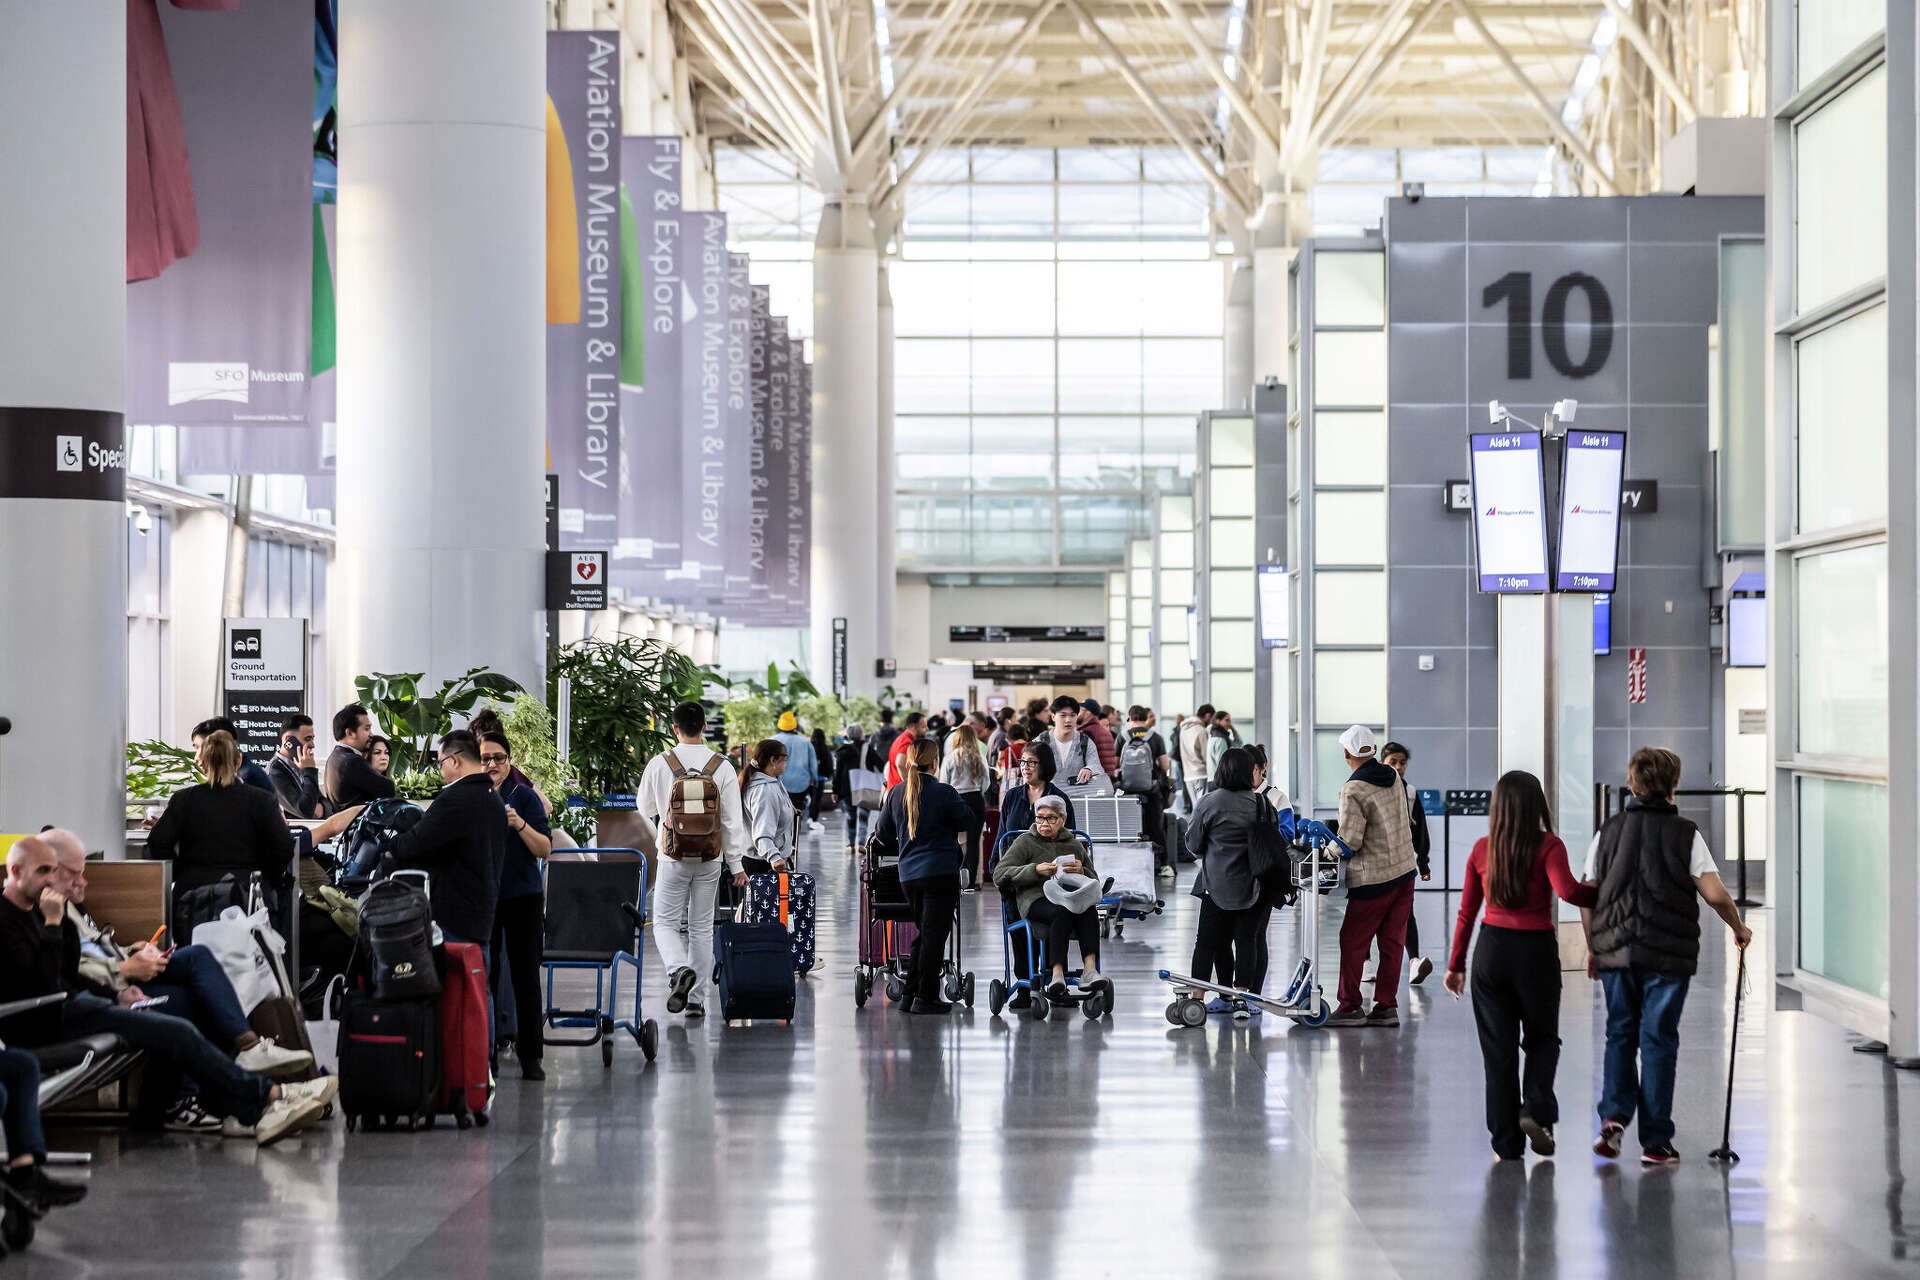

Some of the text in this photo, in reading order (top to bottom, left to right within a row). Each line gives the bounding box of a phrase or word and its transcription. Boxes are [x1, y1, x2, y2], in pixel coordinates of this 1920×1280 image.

[586, 35, 616, 172] Aviation
[586, 183, 616, 328] Museum
[648, 139, 680, 333] Fly & Explore
[703, 214, 725, 314] Aviation
[586, 338, 616, 362] &
[727, 255, 750, 410] Fly & Explore
[1482, 271, 1613, 380] 10
[215, 369, 305, 382] SFO Museum
[703, 322, 725, 429] Museum
[770, 372, 788, 451] Explore
[578, 373, 616, 488] Library
[703, 435, 725, 455] &
[751, 379, 769, 470] Museum
[1489, 436, 1521, 448] Aisle 11
[1581, 435, 1609, 447] Aisle 11
[696, 461, 725, 547] Library
[750, 496, 769, 569] Library
[1499, 577, 1529, 589] 7:10pm
[1573, 576, 1599, 588] 7:10pm
[231, 662, 265, 671] Ground
[231, 673, 297, 683] Transportation
[260, 705, 280, 713] Parking
